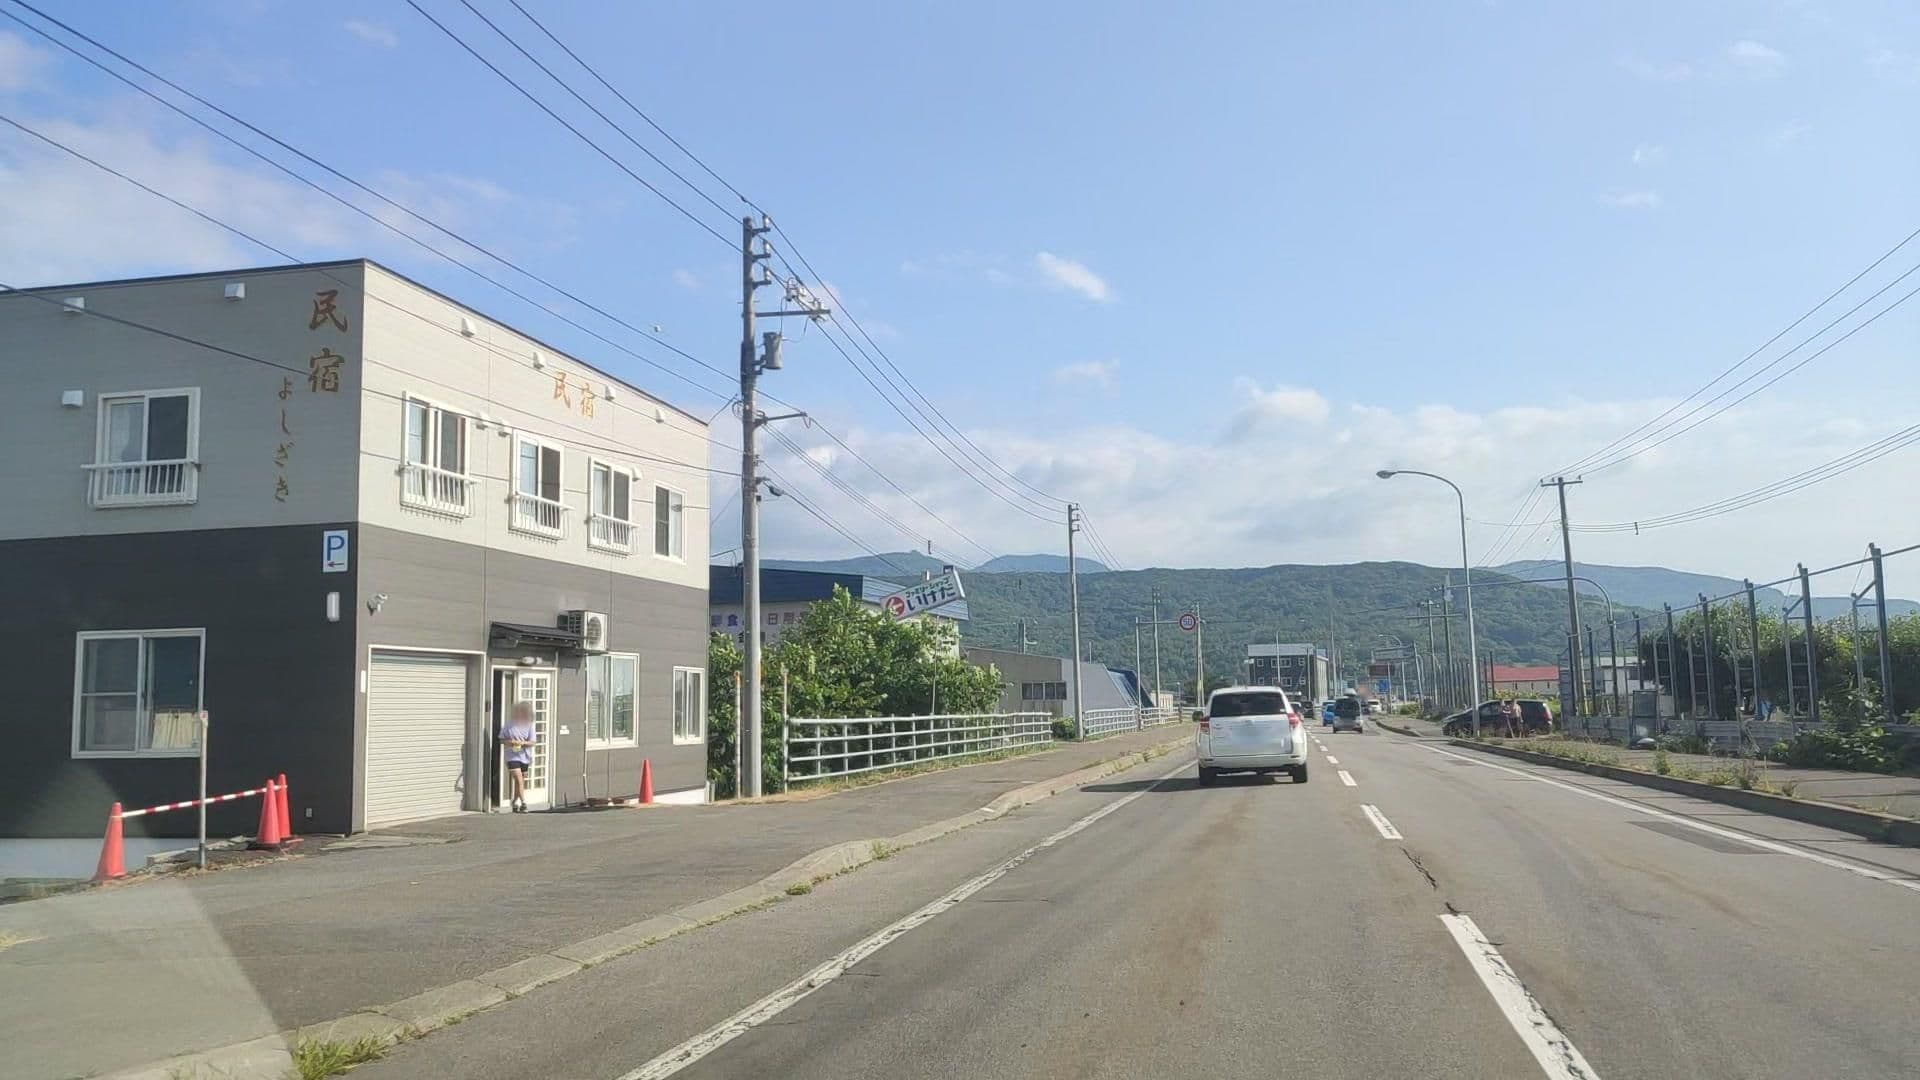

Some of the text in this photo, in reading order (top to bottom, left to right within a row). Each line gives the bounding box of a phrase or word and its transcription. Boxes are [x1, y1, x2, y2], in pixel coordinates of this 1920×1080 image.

[308, 289, 348, 393] 民宿
[553, 371, 596, 418] 民宿
[274, 376, 295, 503] よしざき
[327, 535, 345, 561] P
[906, 583, 956, 611] いけだ
